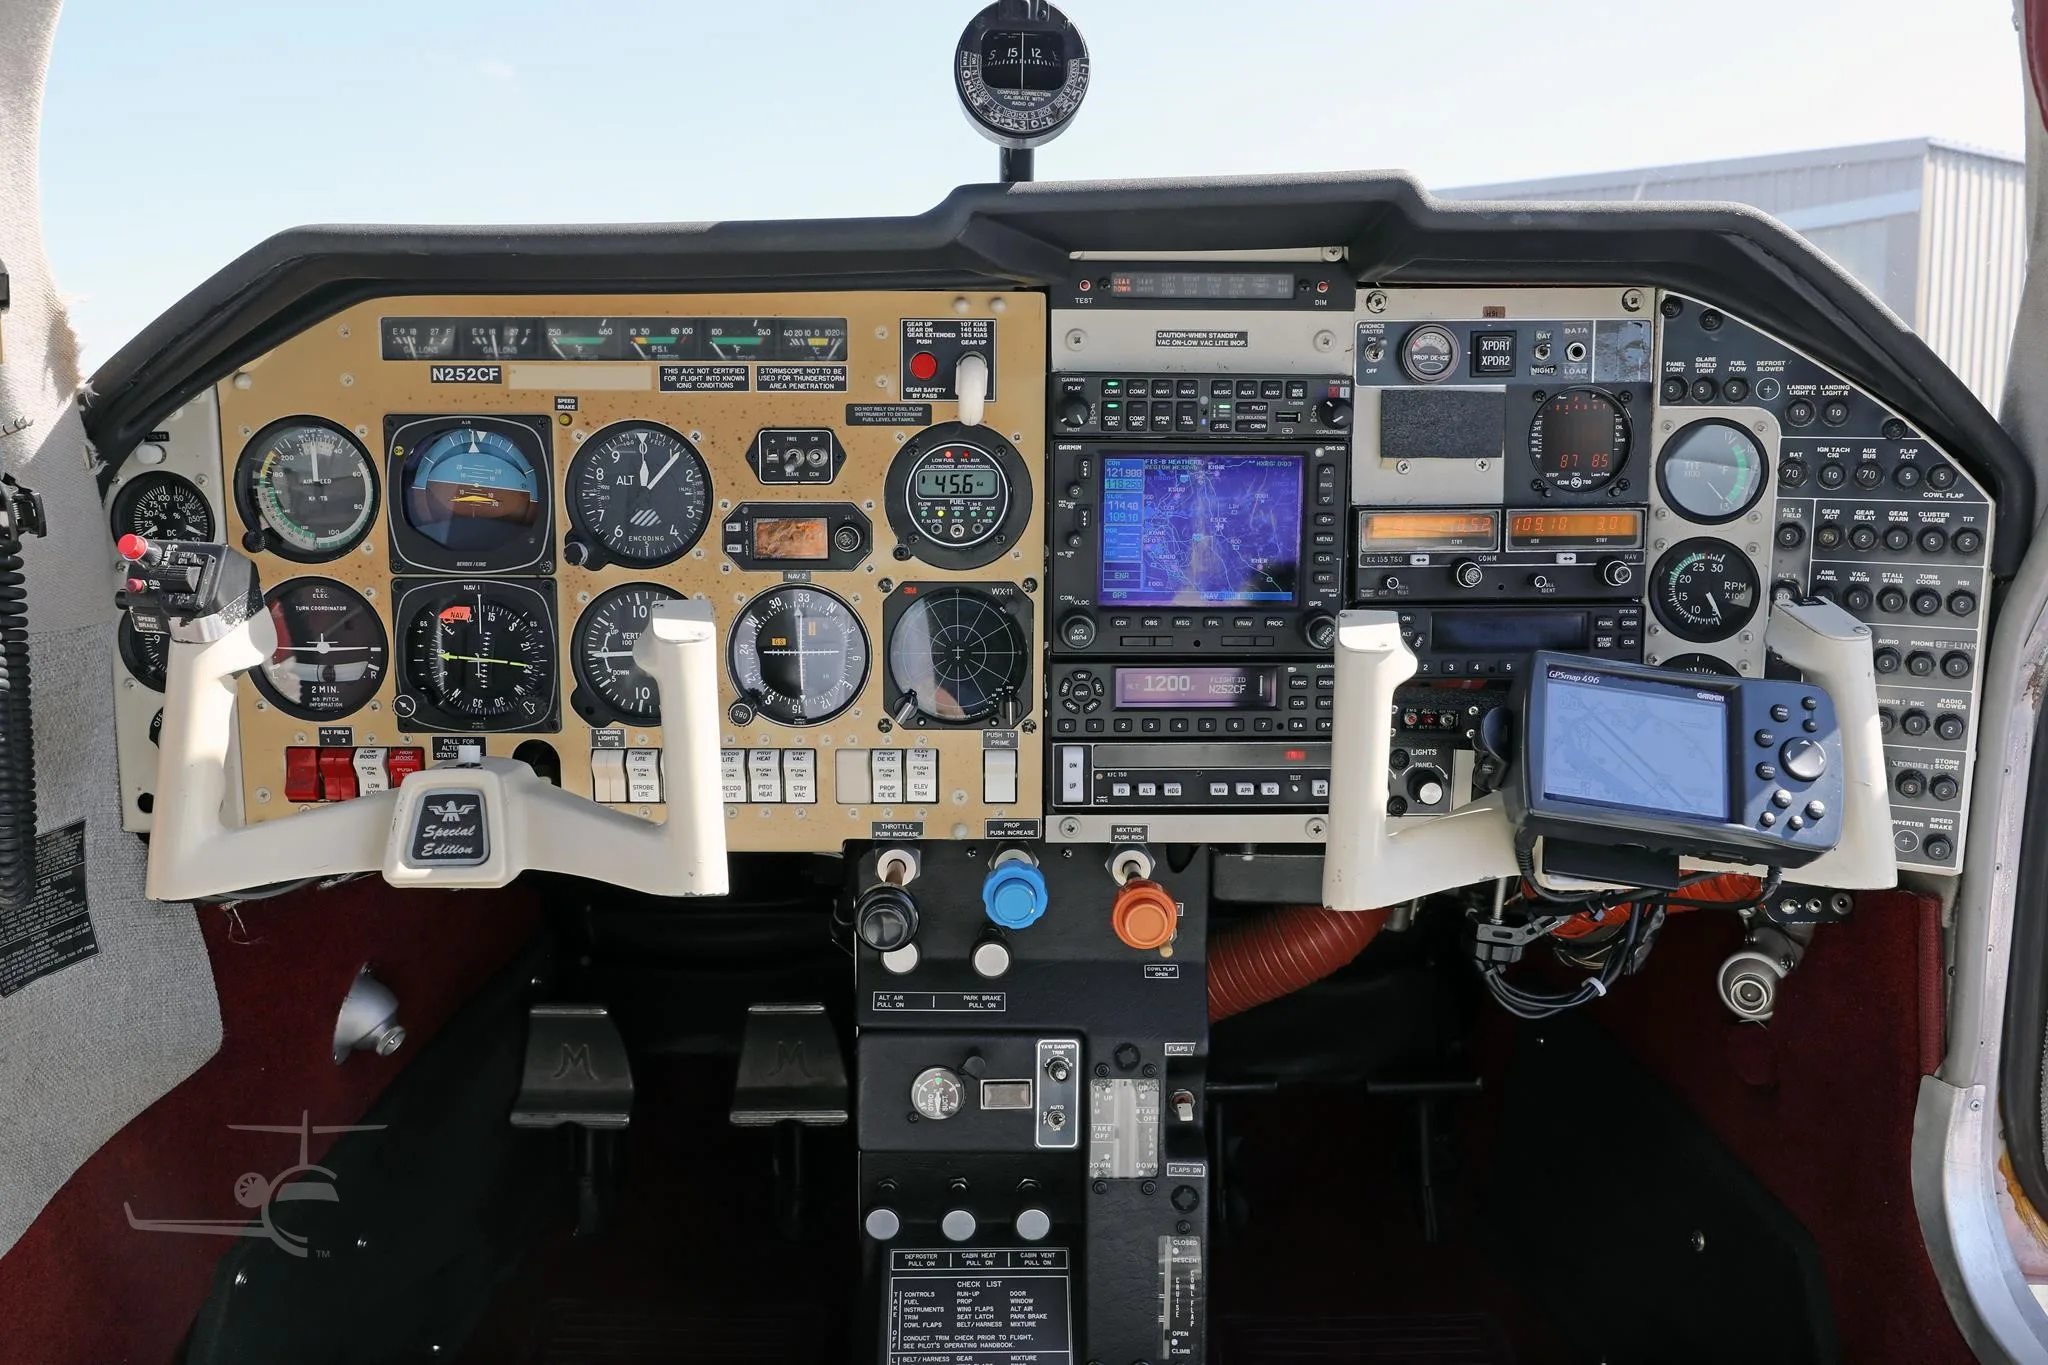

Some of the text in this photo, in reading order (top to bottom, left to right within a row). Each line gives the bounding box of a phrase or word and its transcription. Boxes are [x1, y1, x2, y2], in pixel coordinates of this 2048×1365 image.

[1007, 48, 1018, 57] 15
[1031, 48, 1042, 58] 12
[1564, 327, 1588, 335] DATA
[1482, 340, 1510, 351] XPDR1
[1481, 355, 1510, 366] XPDR2
[432, 368, 499, 381] N252CF
[1564, 367, 1587, 375] LOAD
[616, 475, 635, 486] ALT
[1922, 491, 1945, 499] COWL
[1692, 563, 1705, 573] 25
[1710, 563, 1724, 573] 30
[1723, 581, 1747, 591] RPM
[991, 587, 1013, 596] WX-11
[1548, 669, 1600, 684] GPSmap 496
[1143, 675, 1191, 692] 1200
[318, 686, 340, 694] MIN.
[1208, 684, 1246, 694] N252CF
[422, 825, 476, 838] Special
[421, 843, 473, 857] Edition
